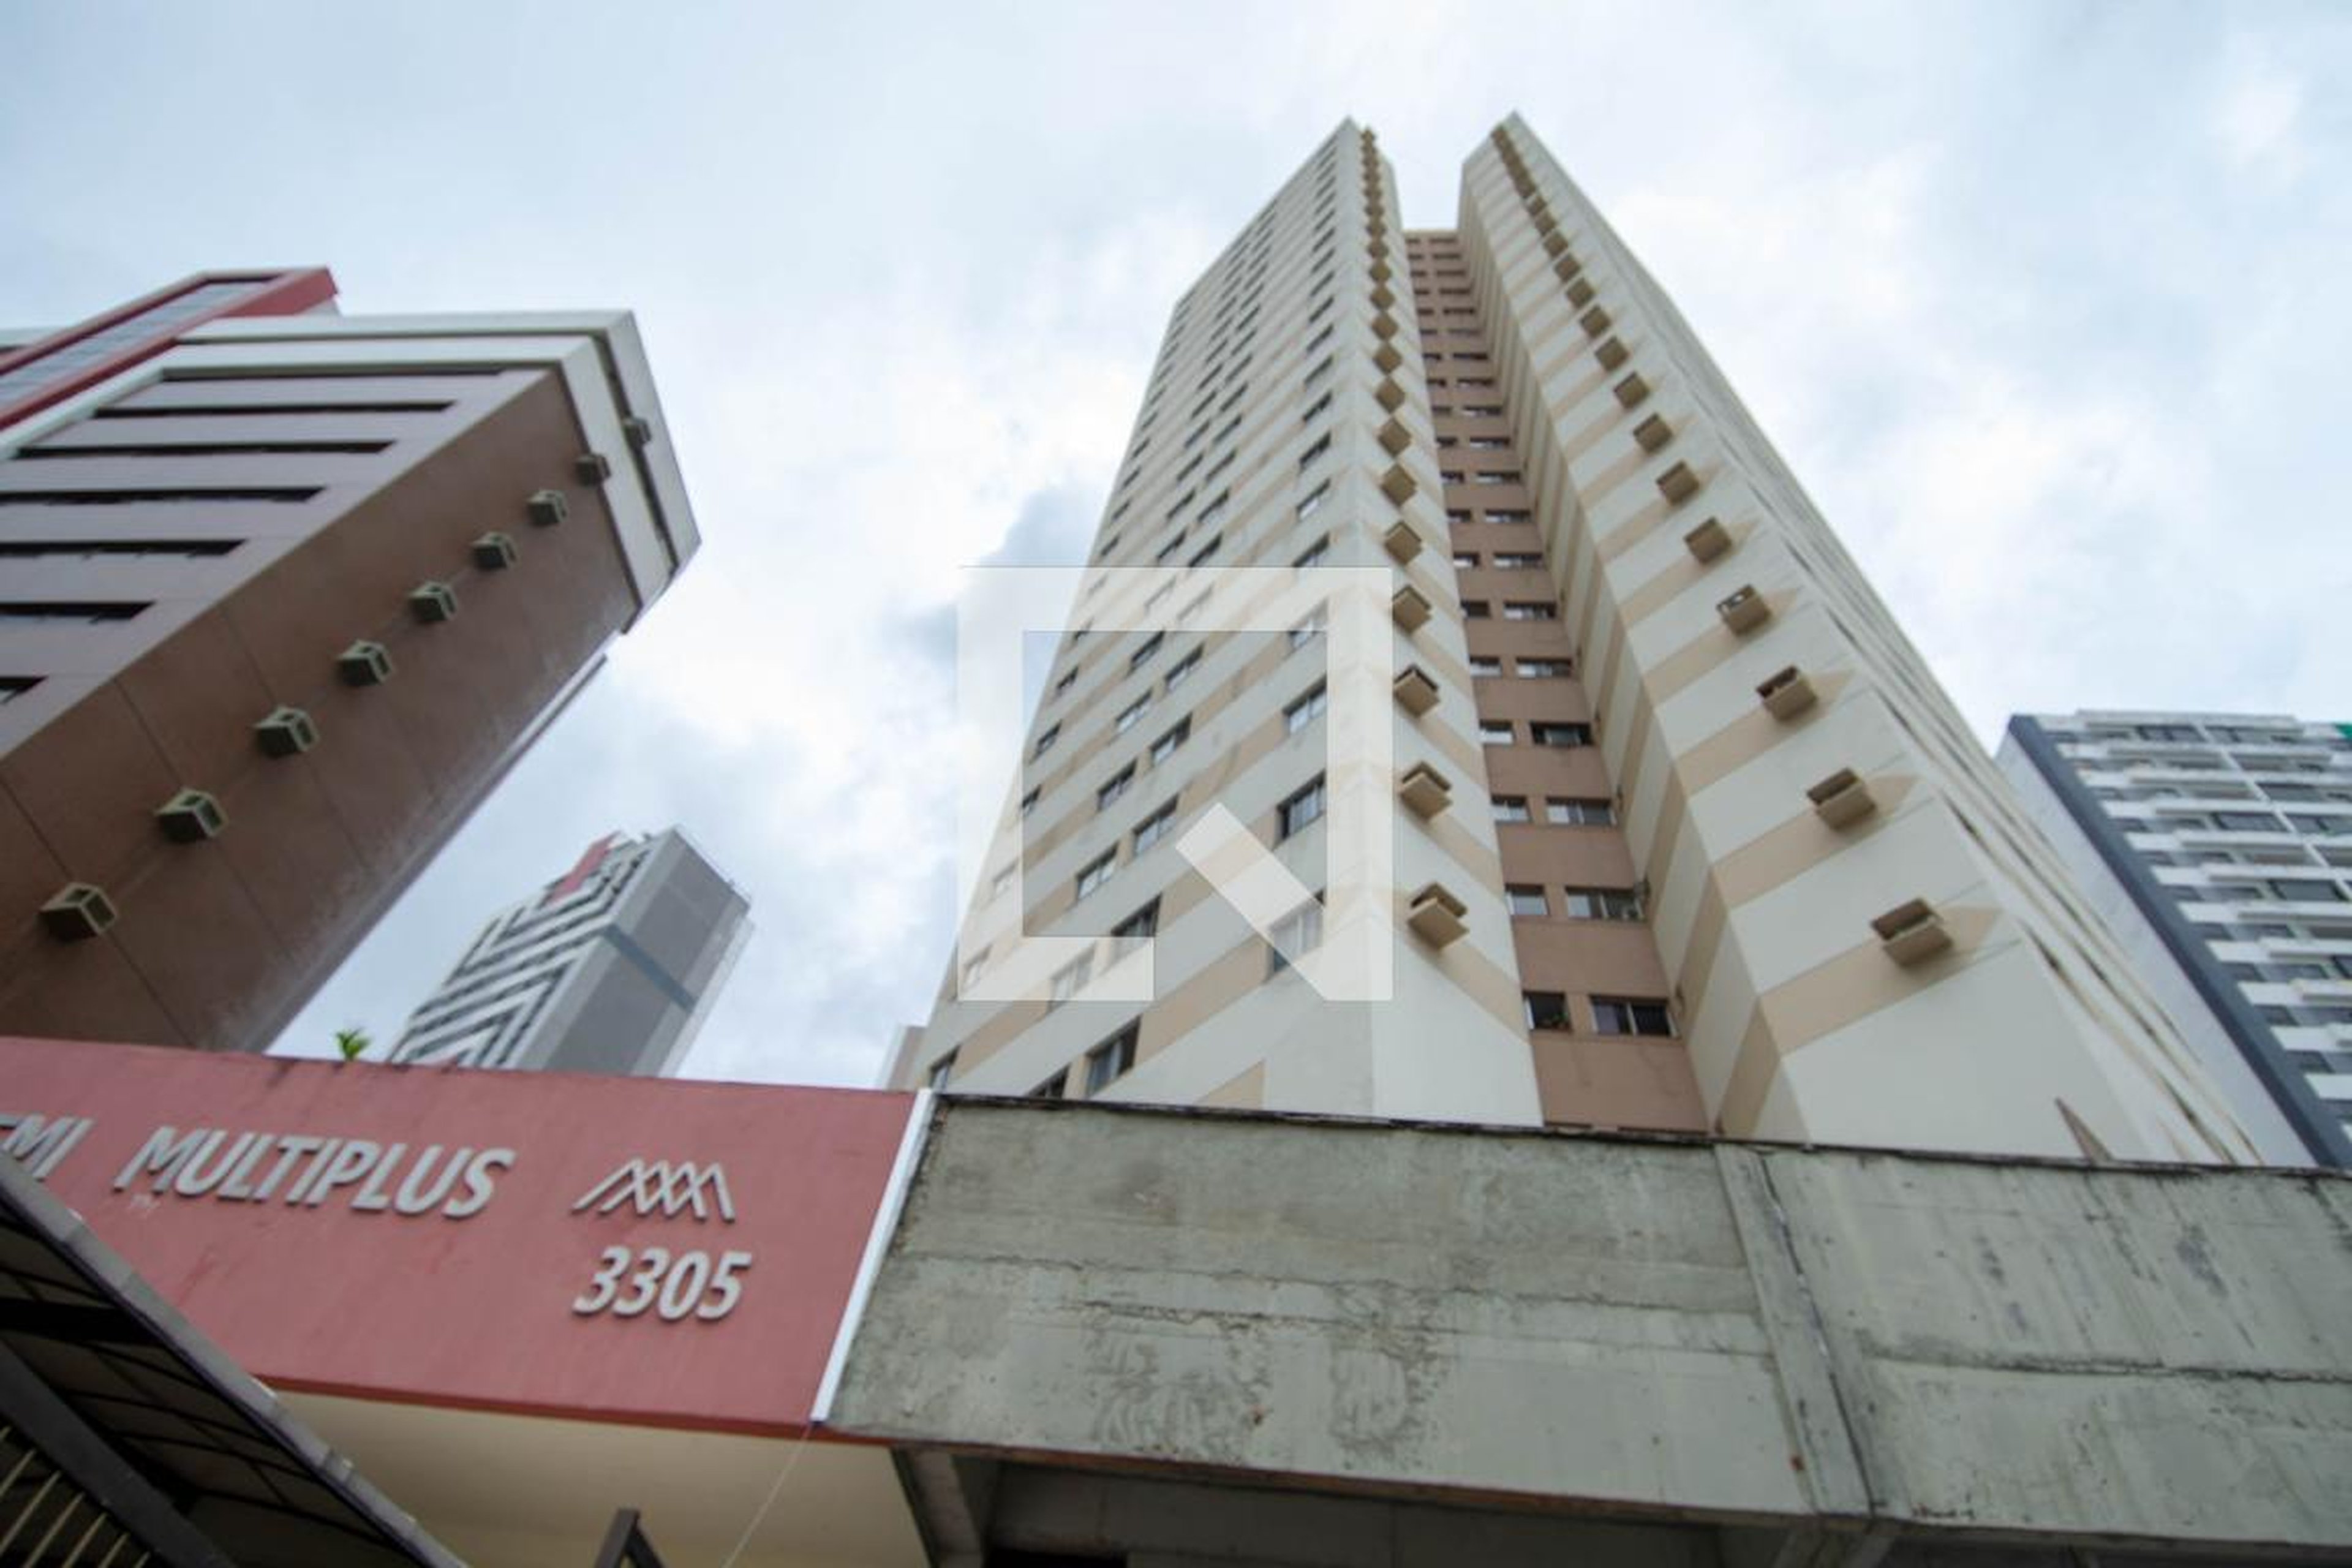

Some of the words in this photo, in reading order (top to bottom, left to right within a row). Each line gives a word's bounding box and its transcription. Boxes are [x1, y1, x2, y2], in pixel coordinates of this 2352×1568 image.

[0, 1112, 94, 1179] MI
[112, 1125, 516, 1218] MULTIPLUS
[571, 1246, 752, 1321] 3305
